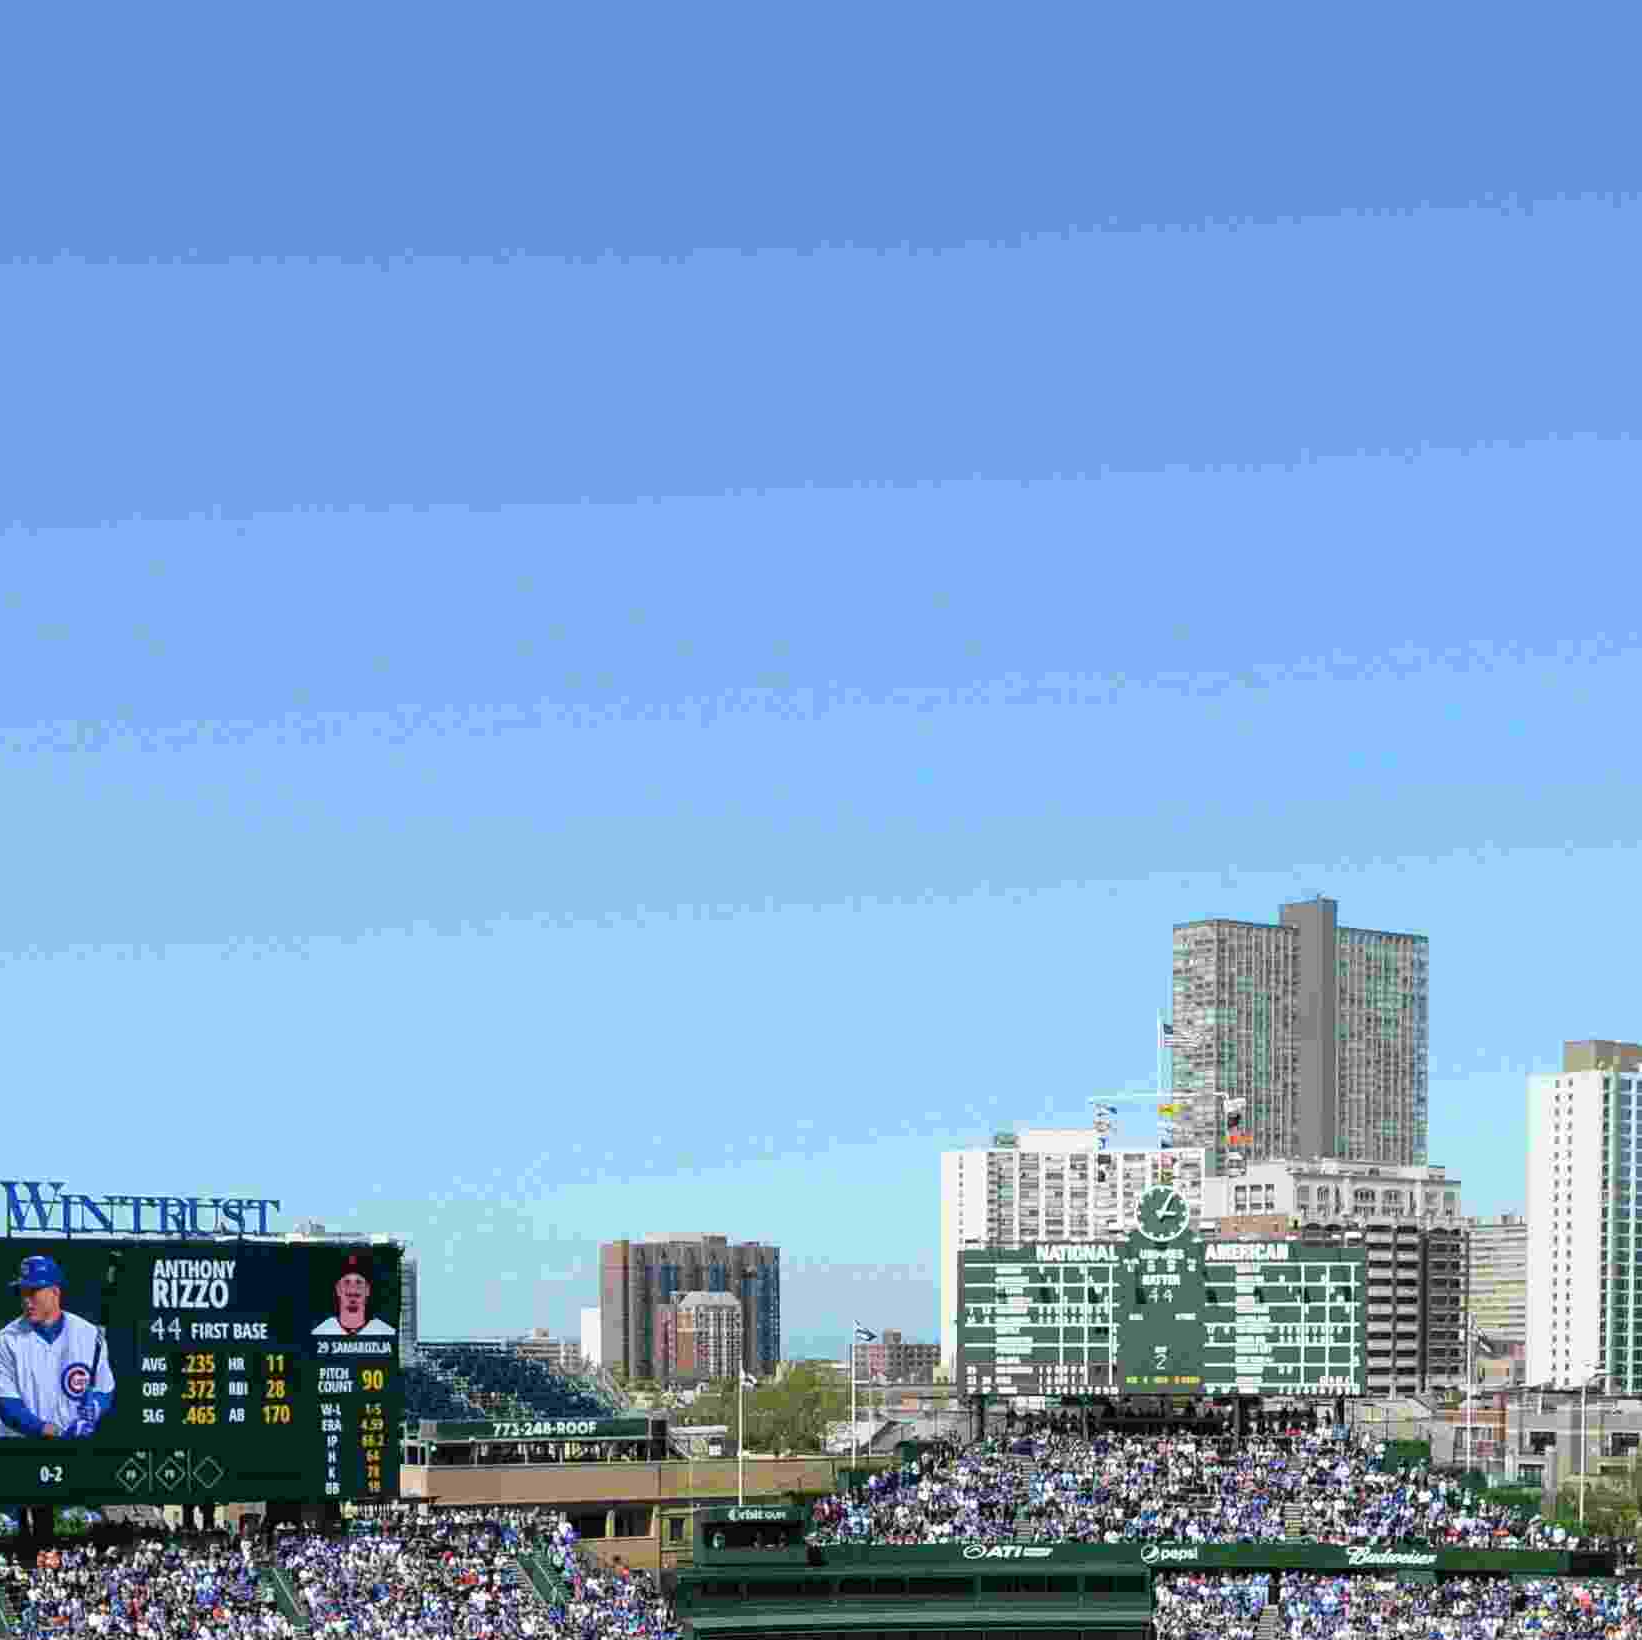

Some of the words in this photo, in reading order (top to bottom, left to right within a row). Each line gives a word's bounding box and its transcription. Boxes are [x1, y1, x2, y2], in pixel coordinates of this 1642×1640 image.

[0, 1181, 281, 1233] WINTRUST
[1036, 1244, 1119, 1261] NATIONAL
[1205, 1243, 1289, 1260] AMERICAN
[153, 1259, 237, 1279] ANTHONY
[152, 1279, 229, 1309] RIZZO
[1149, 1288, 1173, 1303] 44
[150, 1316, 182, 1341] 44
[190, 1322, 230, 1341] FIRST
[233, 1322, 269, 1341] BASE
[141, 1356, 169, 1373] AVG
[181, 1353, 215, 1374] .235
[228, 1356, 245, 1372] HR
[265, 1353, 285, 1374] 11
[1156, 1353, 1167, 1370] 2
[319, 1367, 350, 1380] PITCH
[361, 1369, 384, 1392] 90
[181, 1379, 216, 1400] .372
[265, 1379, 286, 1400] 28
[318, 1380, 354, 1393] COUNT
[142, 1407, 166, 1424] SLG
[181, 1405, 216, 1425] .465
[228, 1407, 245, 1423] AB
[262, 1404, 292, 1425] 170
[492, 1421, 597, 1437] 773-248-ROOF
[327, 1450, 337, 1465] H
[39, 1465, 63, 1483] 0-2
[327, 1465, 337, 1481] K
[986, 1545, 1023, 1559] ATI
[1160, 1547, 1198, 1562] pepsi
[1345, 1546, 1438, 1566] Budweiser
